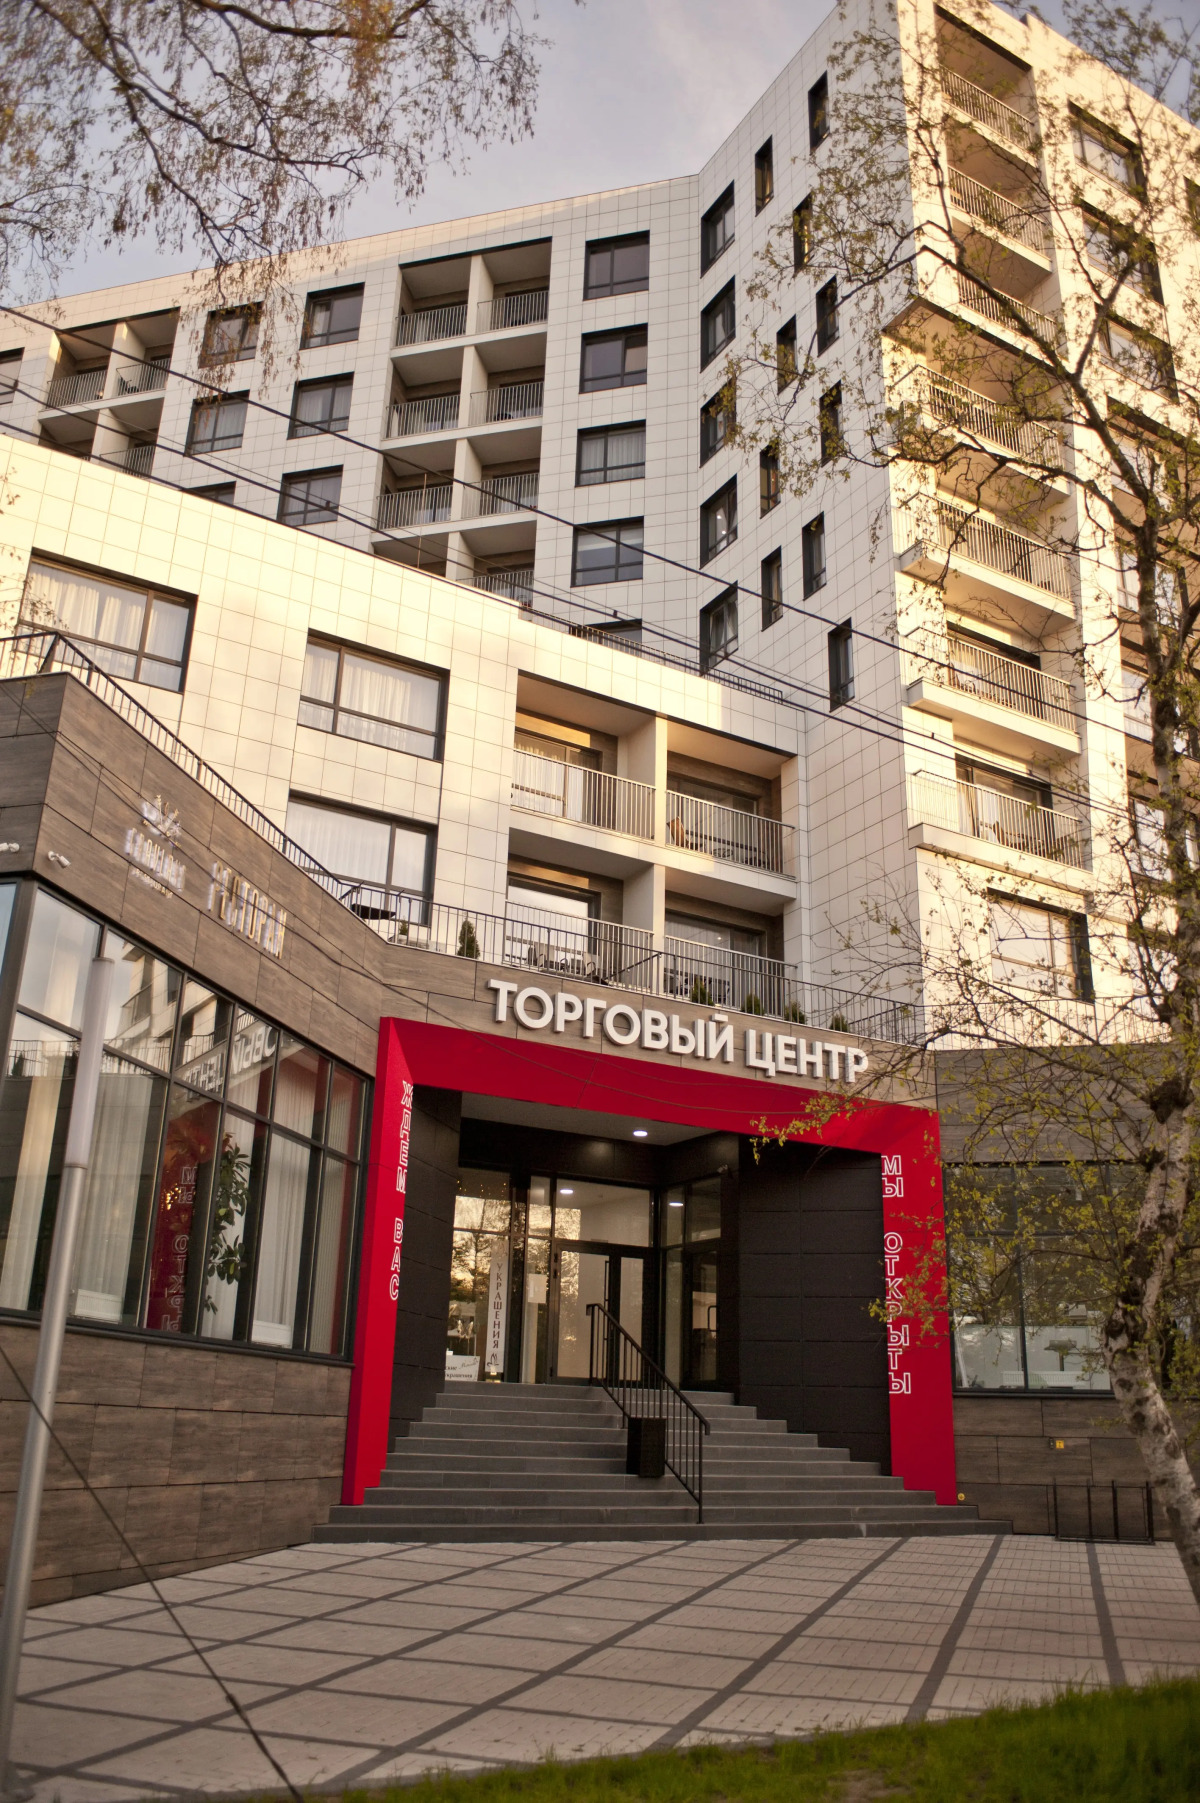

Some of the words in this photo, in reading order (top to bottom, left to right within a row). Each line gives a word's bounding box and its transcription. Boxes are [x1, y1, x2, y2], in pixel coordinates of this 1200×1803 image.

[207, 860, 288, 961] РЕСТОРАН
[487, 978, 735, 1063] ТОРГОВЫЙ
[745, 1029, 869, 1084] ЦЕНТР
[395, 1079, 414, 1194] ЖДЕМ
[881, 1154, 904, 1197] МЫ
[389, 1217, 403, 1301] ВАС
[491, 1262, 503, 1349] УКРАШЕНИЯ
[883, 1231, 912, 1394] ОТКРЫТЫ
